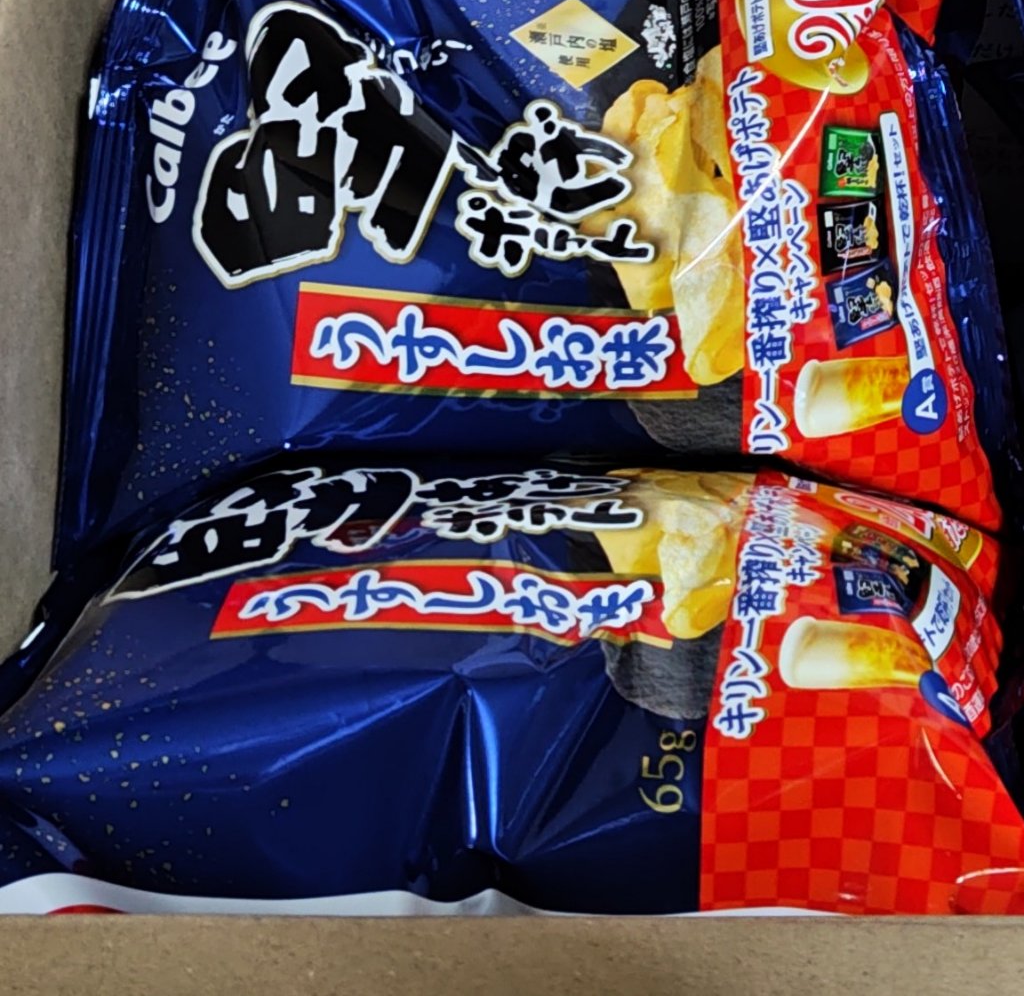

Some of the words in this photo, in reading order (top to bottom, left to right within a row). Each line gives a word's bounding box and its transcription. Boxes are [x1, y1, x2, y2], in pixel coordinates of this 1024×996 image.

[147, 30, 237, 224] Calbee
[783, 181, 820, 321] キャンペーン
[309, 306, 677, 390] うすしお味
[239, 568, 656, 640] うすしお味
[638, 727, 698, 815] 65g
